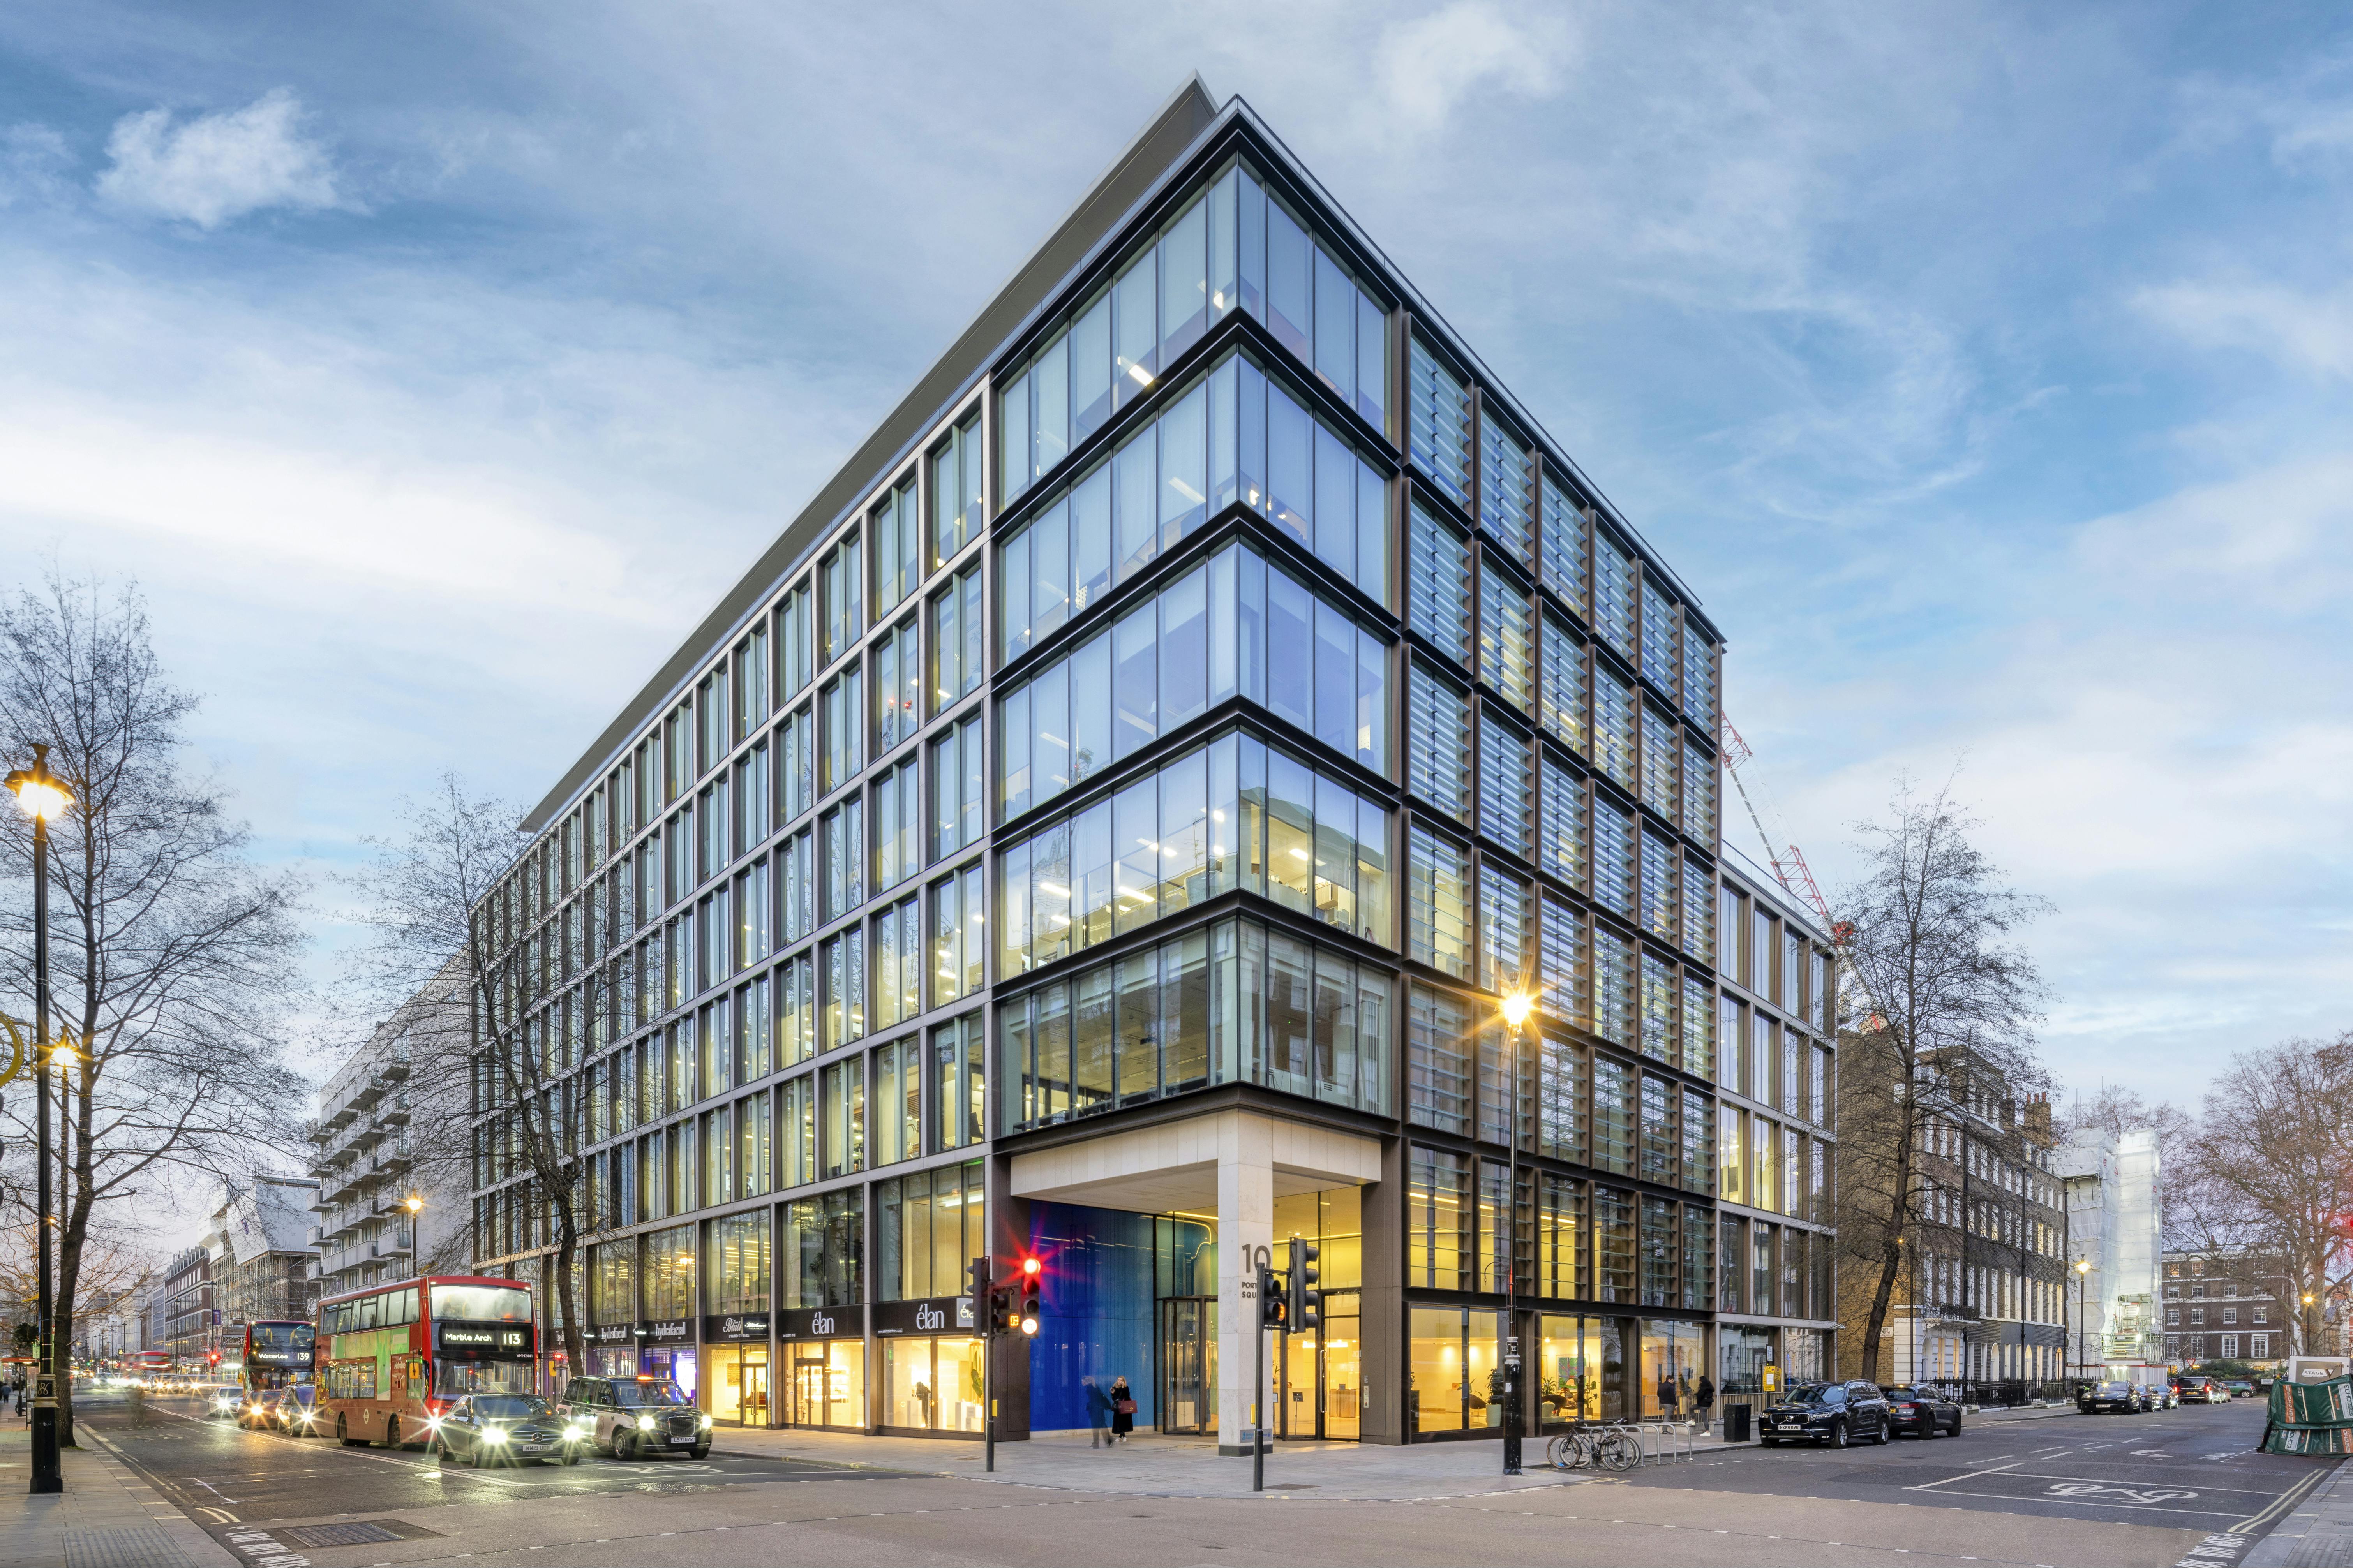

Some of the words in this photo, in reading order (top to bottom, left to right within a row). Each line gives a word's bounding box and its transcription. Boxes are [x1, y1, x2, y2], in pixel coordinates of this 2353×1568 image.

[1242, 1244, 1271, 1273] 10
[916, 1304, 944, 1330] élan
[960, 1304, 974, 1318] éla
[812, 1311, 834, 1334] élan
[504, 1333, 520, 1345] 113
[2325, 1368, 2336, 1378] V
